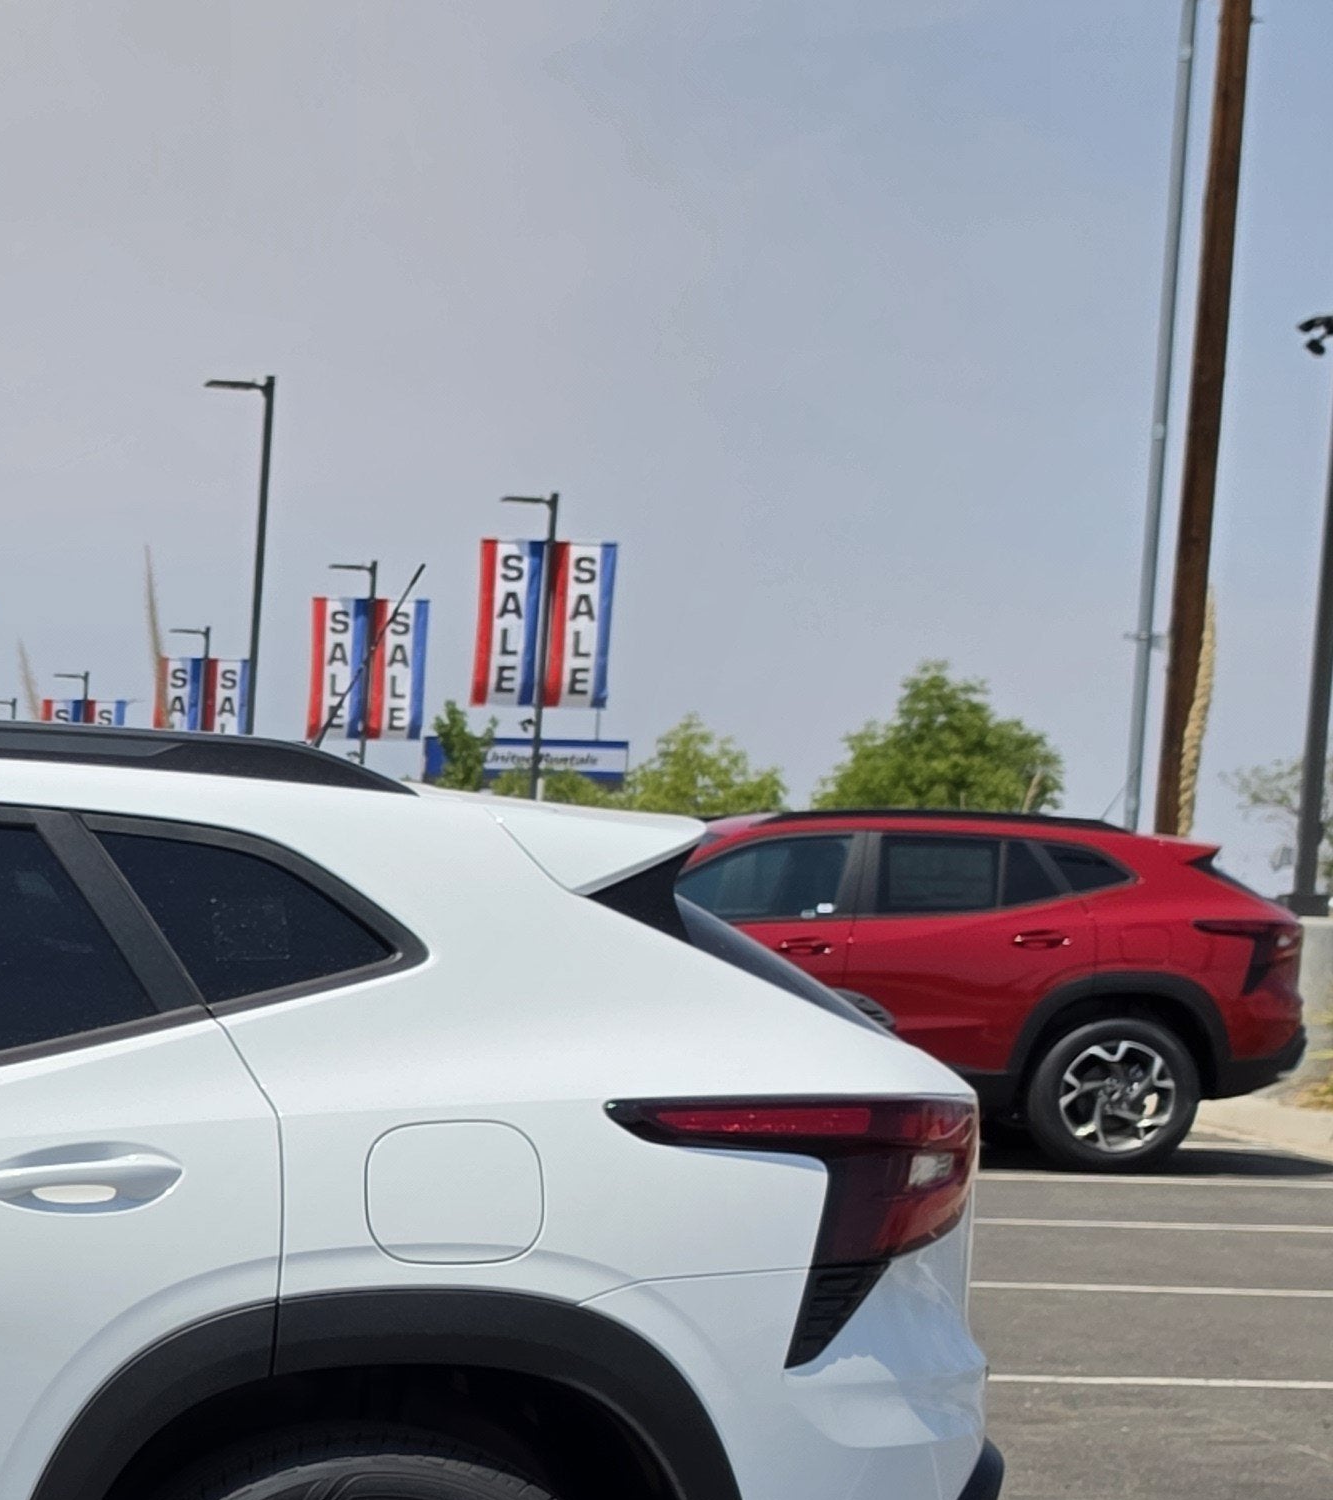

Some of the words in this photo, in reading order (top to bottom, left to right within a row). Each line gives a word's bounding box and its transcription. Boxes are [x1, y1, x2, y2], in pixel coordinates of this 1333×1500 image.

[327, 610, 350, 730] SALE
[387, 611, 411, 732] SALE
[494, 553, 525, 694] SALE
[568, 556, 597, 696] SALE
